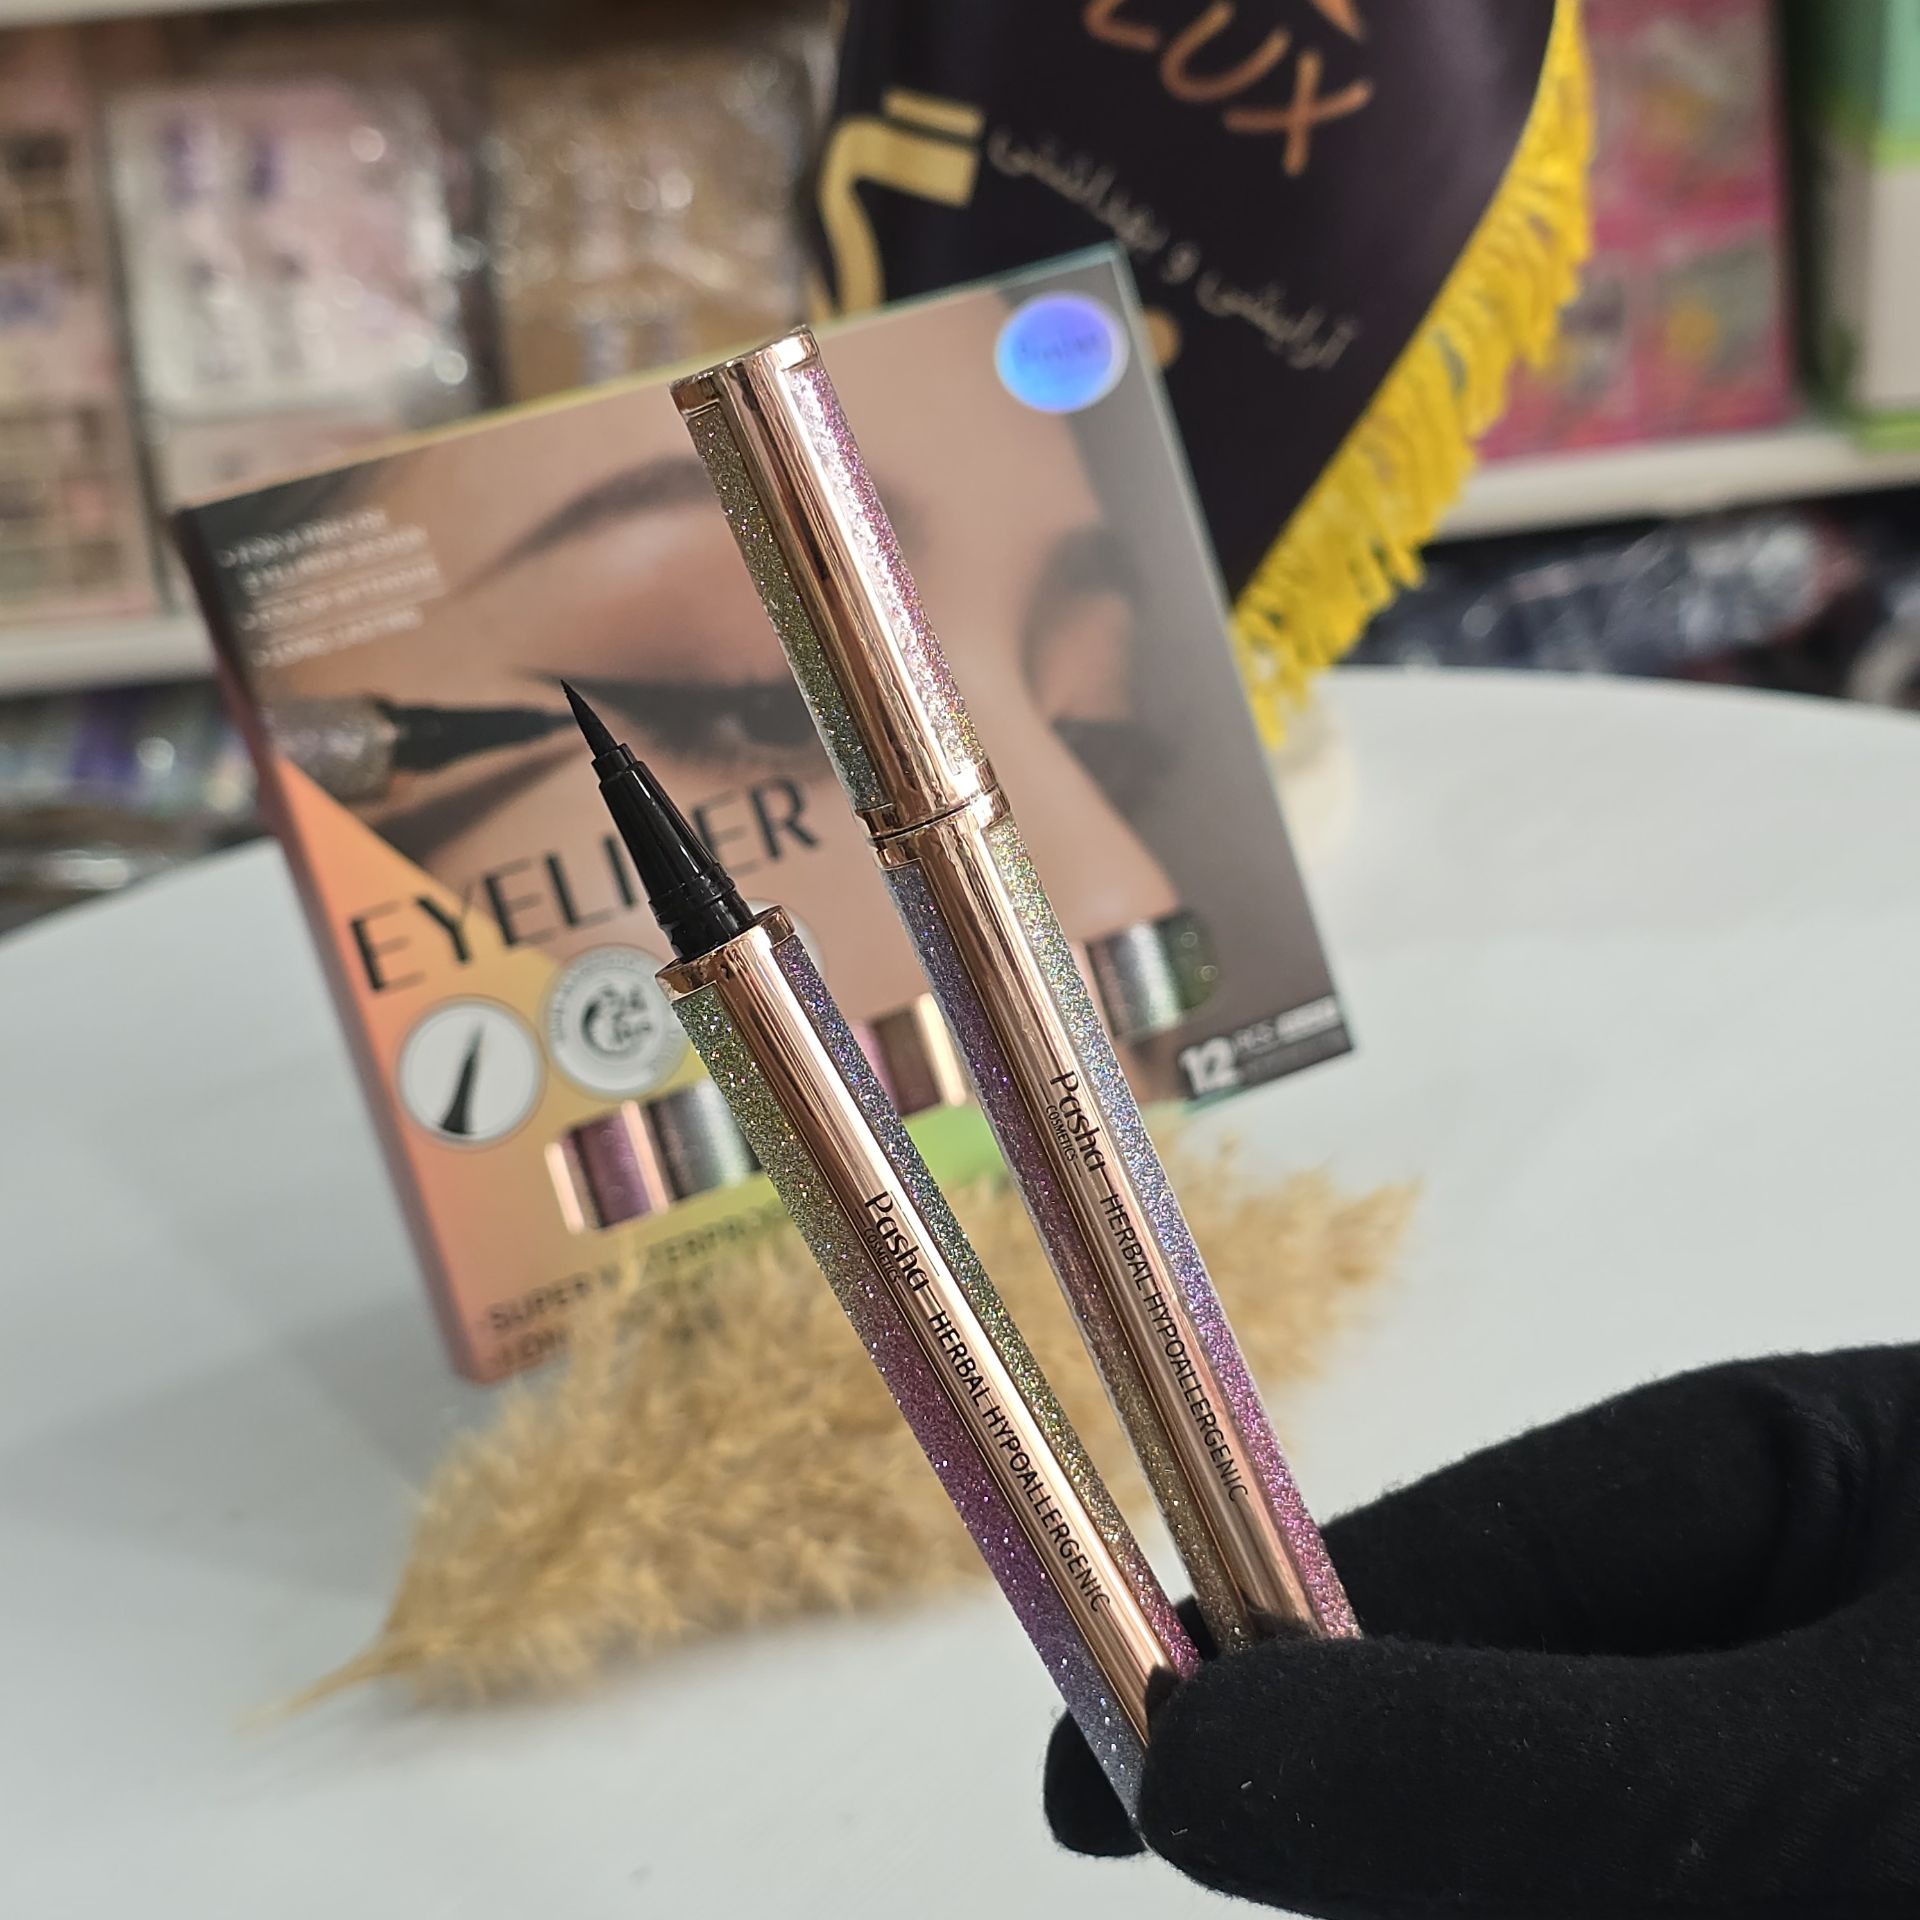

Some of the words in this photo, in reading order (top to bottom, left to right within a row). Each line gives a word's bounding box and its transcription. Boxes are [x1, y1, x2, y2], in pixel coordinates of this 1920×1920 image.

[350, 777, 820, 993] EYELIER
[1178, 1034, 1240, 1094] 12
[1046, 1104, 1079, 1163] COSMETICS
[1050, 1071, 1106, 1173] Pasha
[863, 1227, 900, 1284] COSMETICS
[865, 1190, 931, 1291] Pasha
[1100, 1193, 1153, 1291] HERBAL
[1143, 1291, 1249, 1501] HYPOALLERGENIC
[928, 1310, 991, 1397] HERBAL
[982, 1405, 1111, 1613] HYPOALLERGENIC
